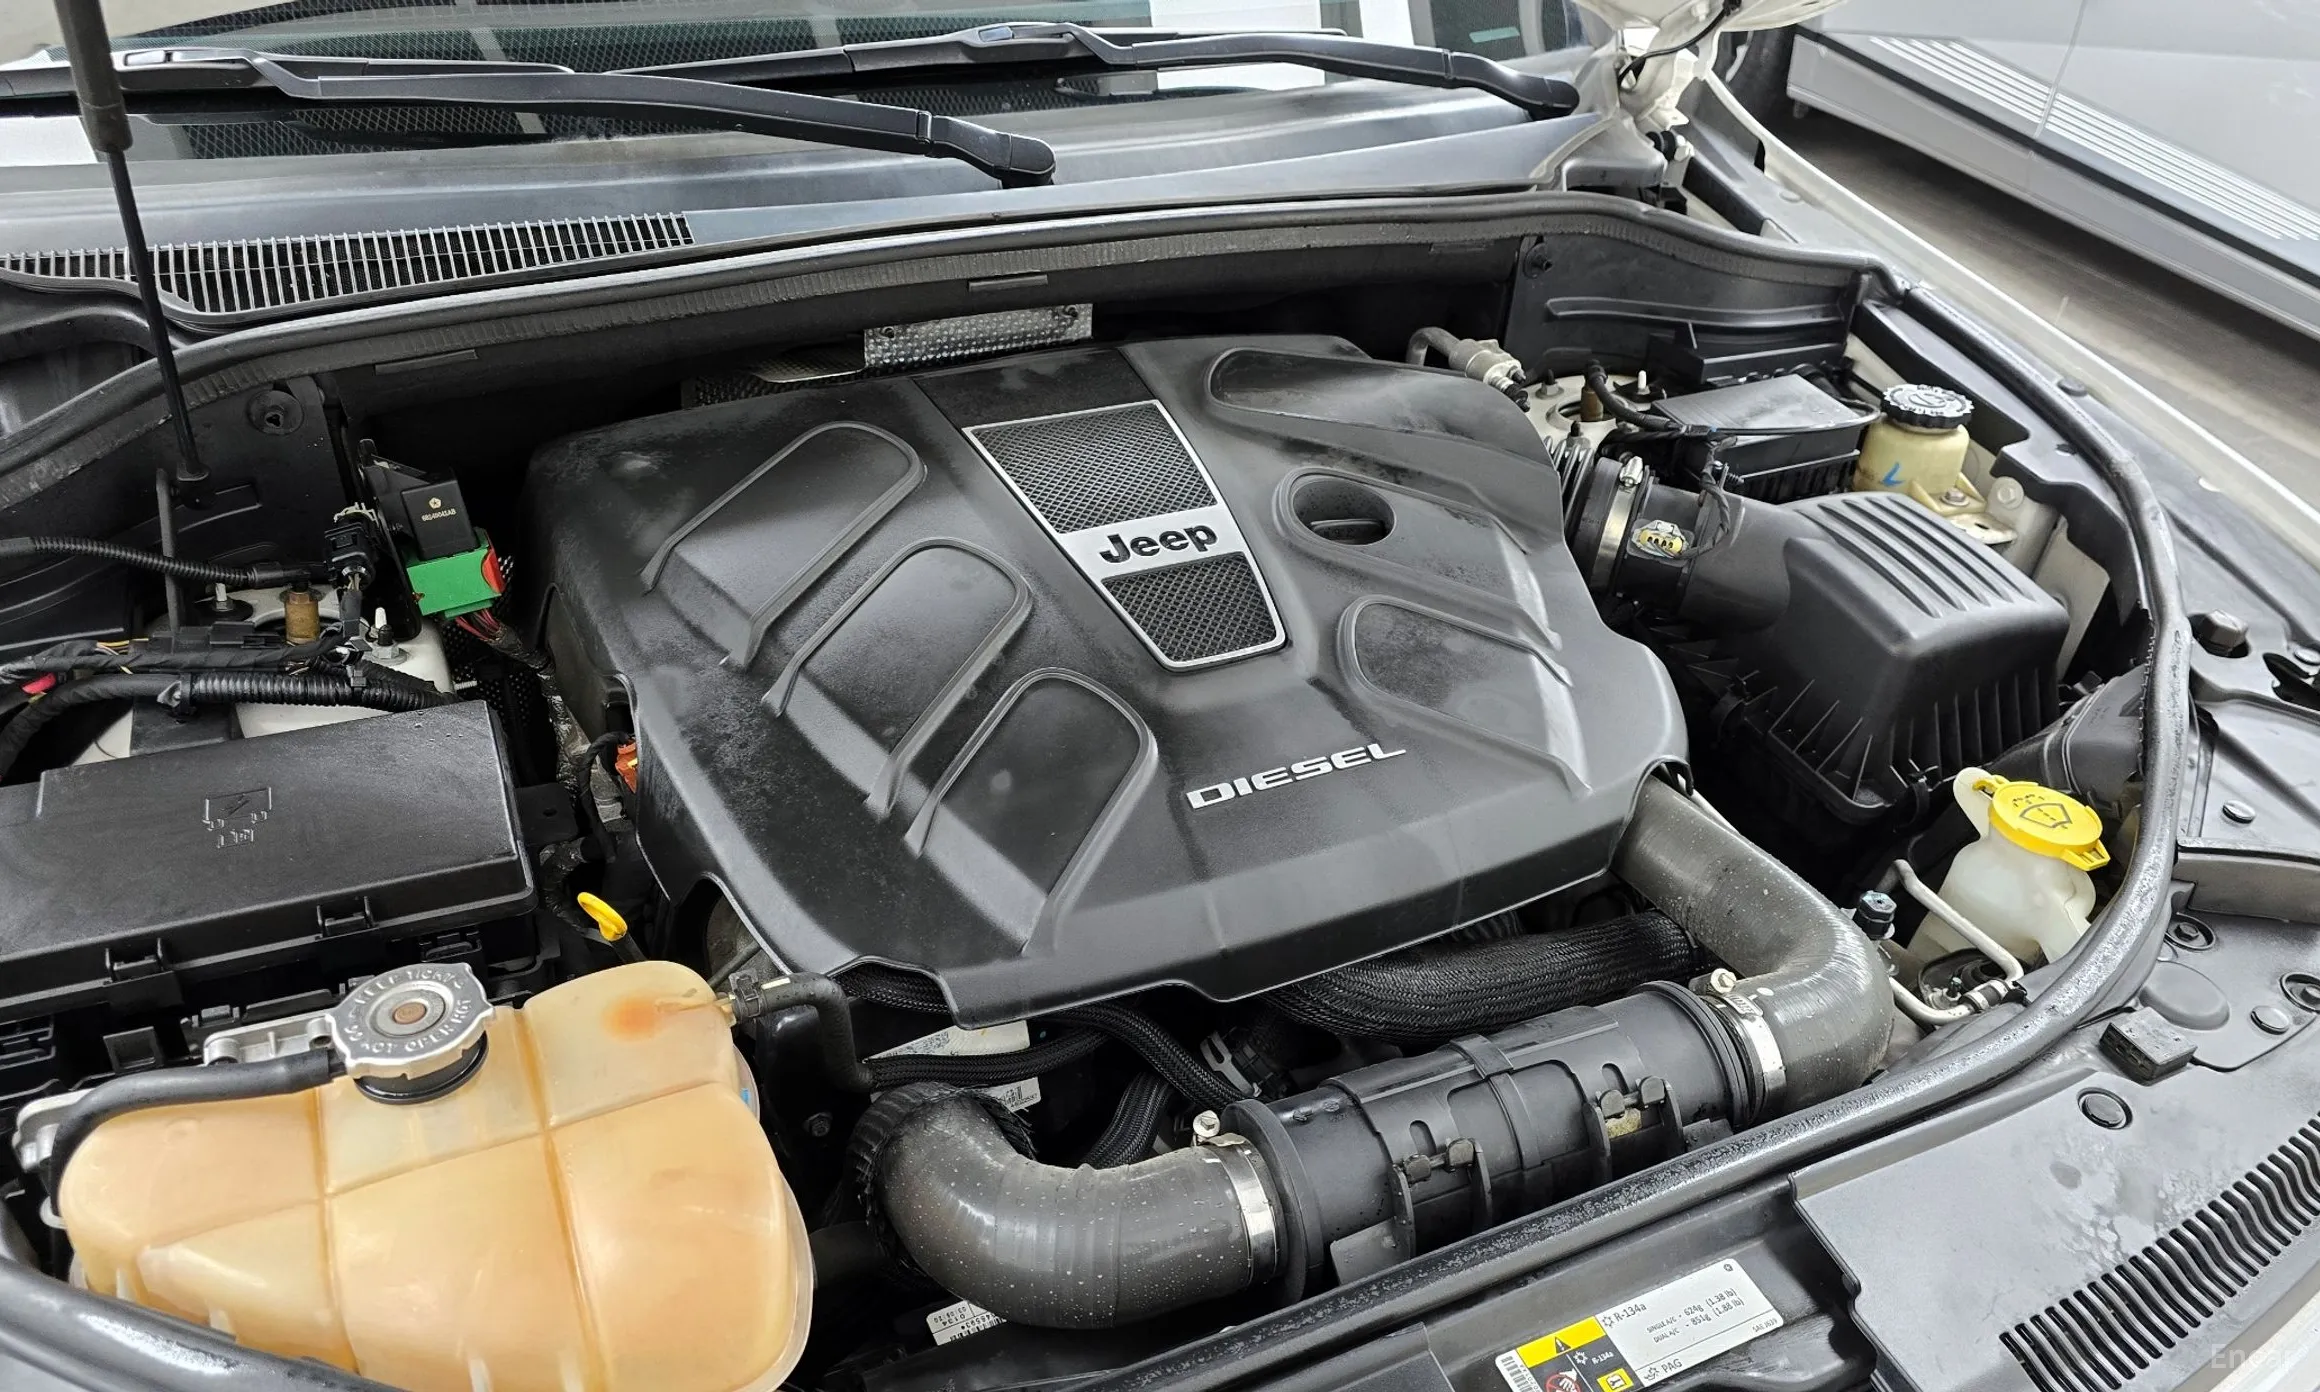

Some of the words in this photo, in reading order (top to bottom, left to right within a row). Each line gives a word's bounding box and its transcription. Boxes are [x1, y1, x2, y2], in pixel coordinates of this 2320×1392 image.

[1099, 525, 1218, 563] Jeep
[1186, 743, 1406, 809] DIESEL
[1614, 1304, 1647, 1323] R-134a
[1683, 1304, 1704, 1316] 624g
[1690, 1313, 1712, 1326] 851g
[1661, 1358, 1683, 1374] PAG
